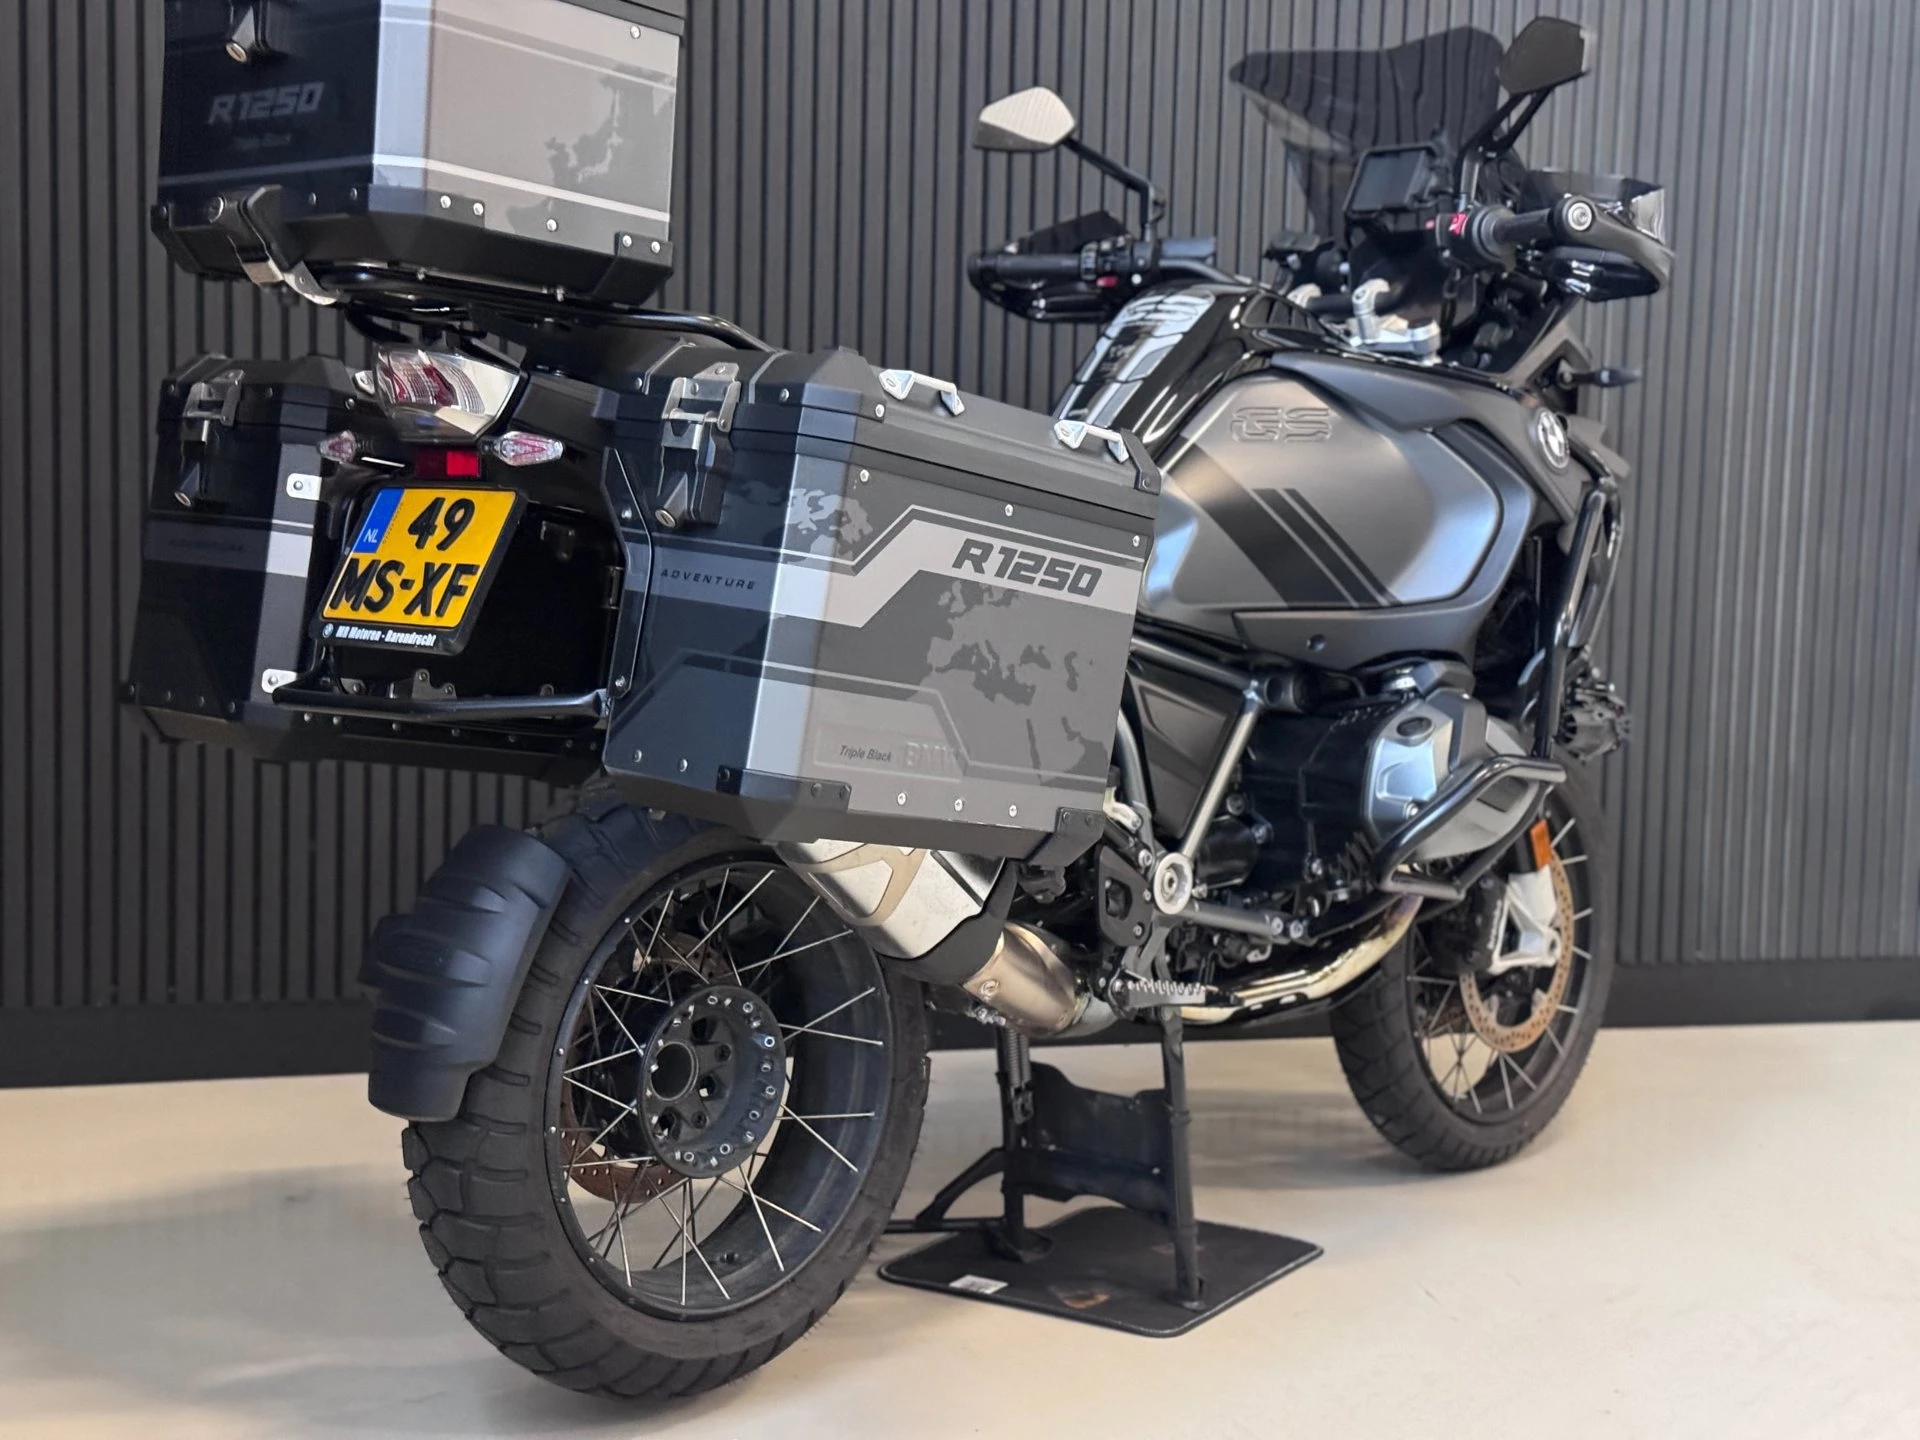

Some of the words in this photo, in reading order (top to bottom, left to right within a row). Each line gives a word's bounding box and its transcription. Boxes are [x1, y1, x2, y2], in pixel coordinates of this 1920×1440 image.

[1230, 406, 1333, 442] GS
[407, 497, 476, 551] 49
[363, 528, 378, 543] NL
[329, 558, 480, 617] MS-XF
[661, 569, 756, 590] ADVENTURE
[348, 626, 382, 641] Motoren
[384, 629, 437, 647] Barendrecht
[840, 744, 865, 760] Triple
[866, 747, 892, 762] Black
